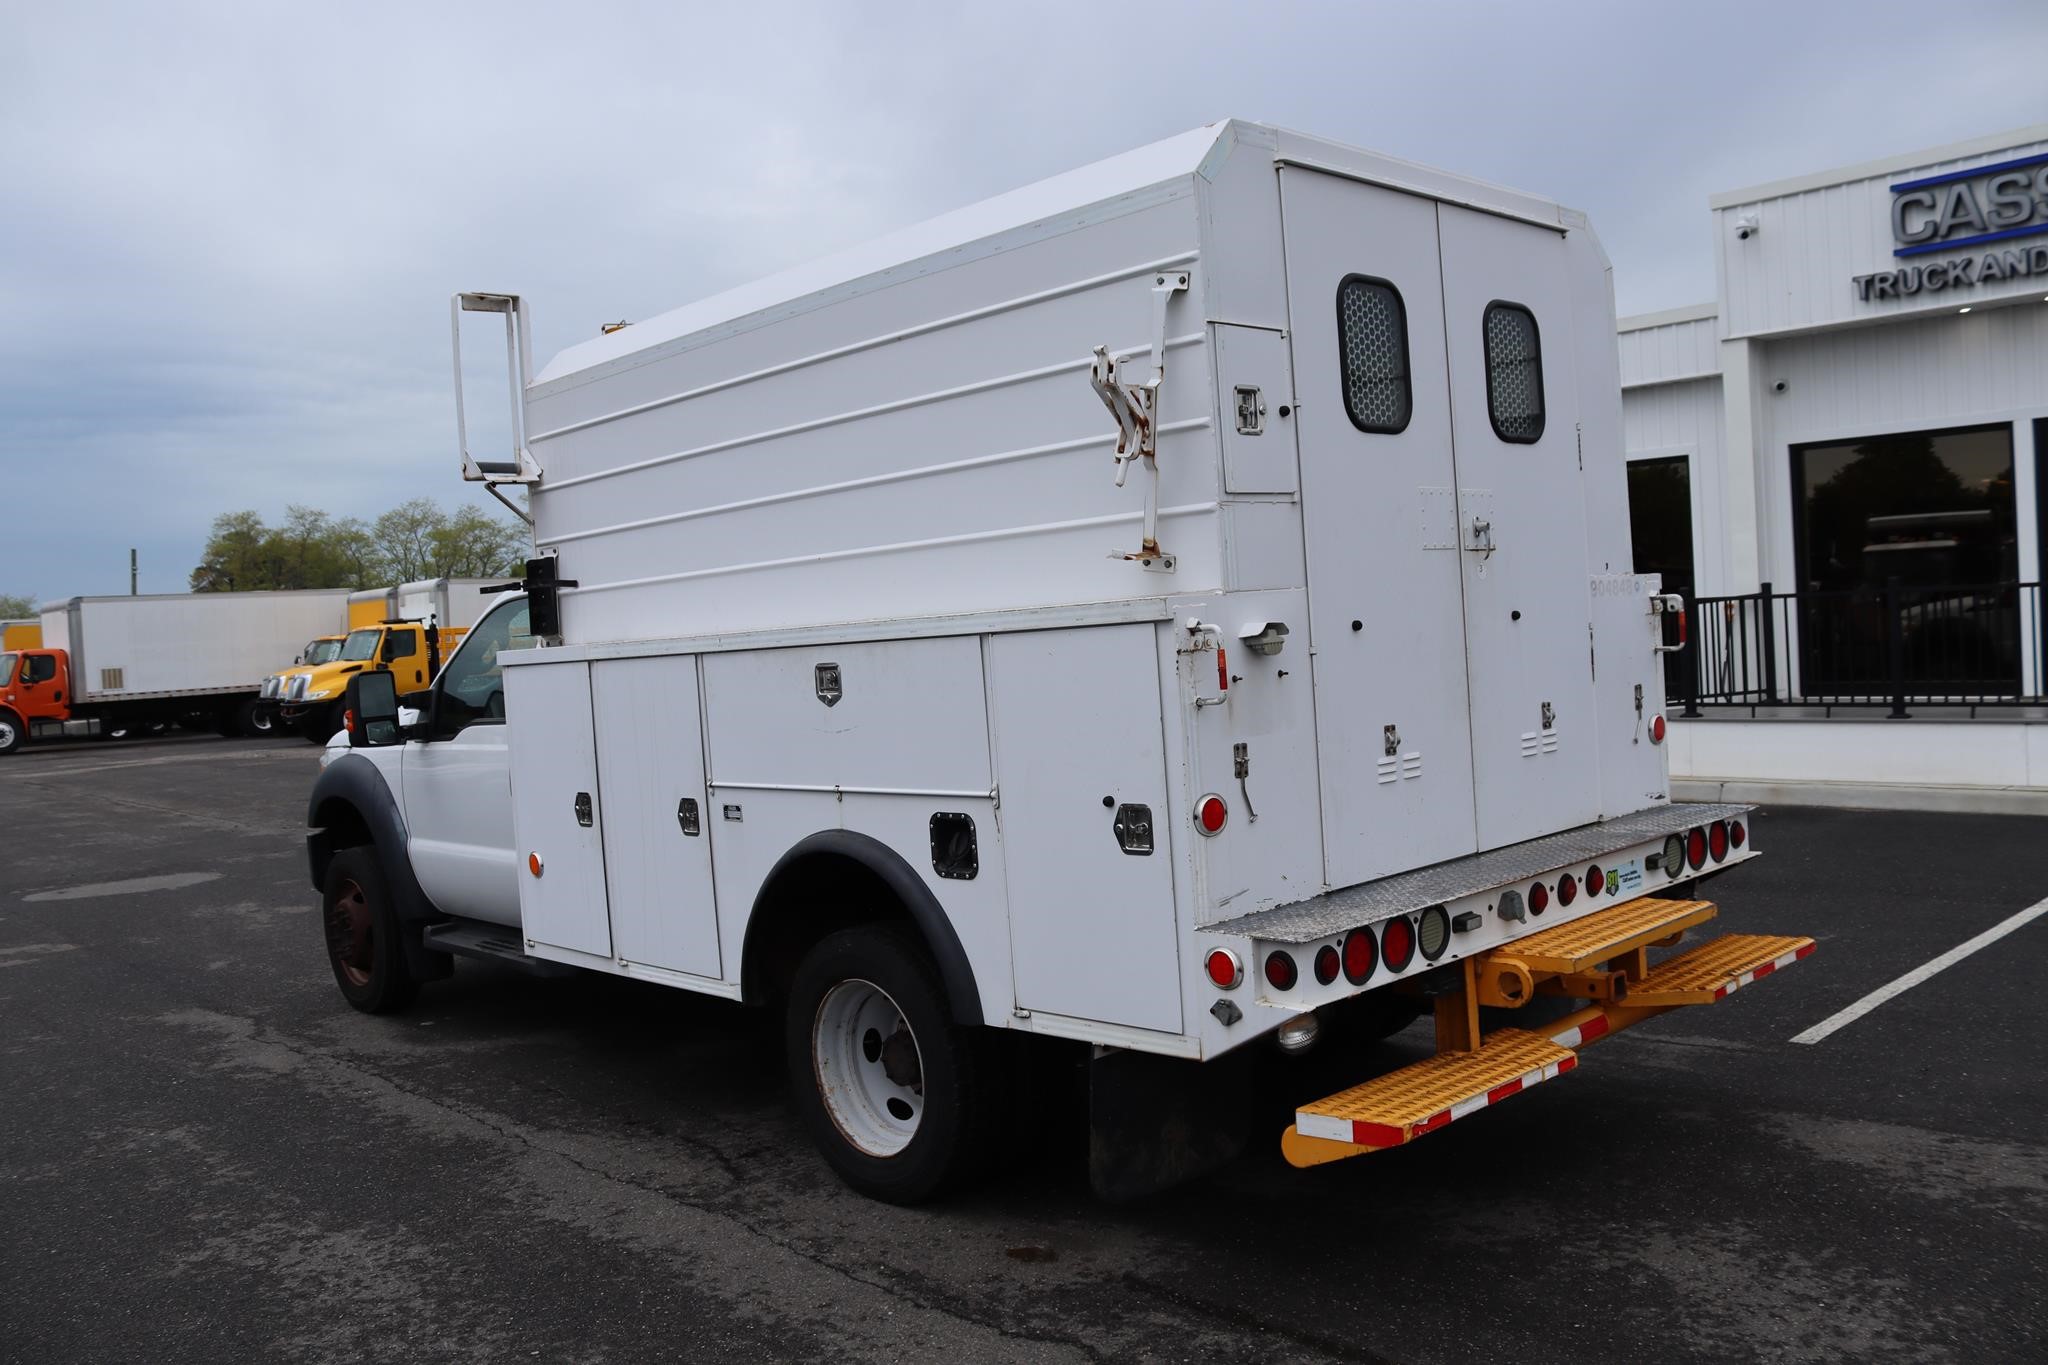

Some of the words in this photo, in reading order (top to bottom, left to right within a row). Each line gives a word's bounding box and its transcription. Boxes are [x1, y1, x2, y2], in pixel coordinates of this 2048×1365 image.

[1891, 167, 2048, 243] CAS
[1852, 257, 1974, 301] TRUCK
[1606, 869, 1618, 888] 811
